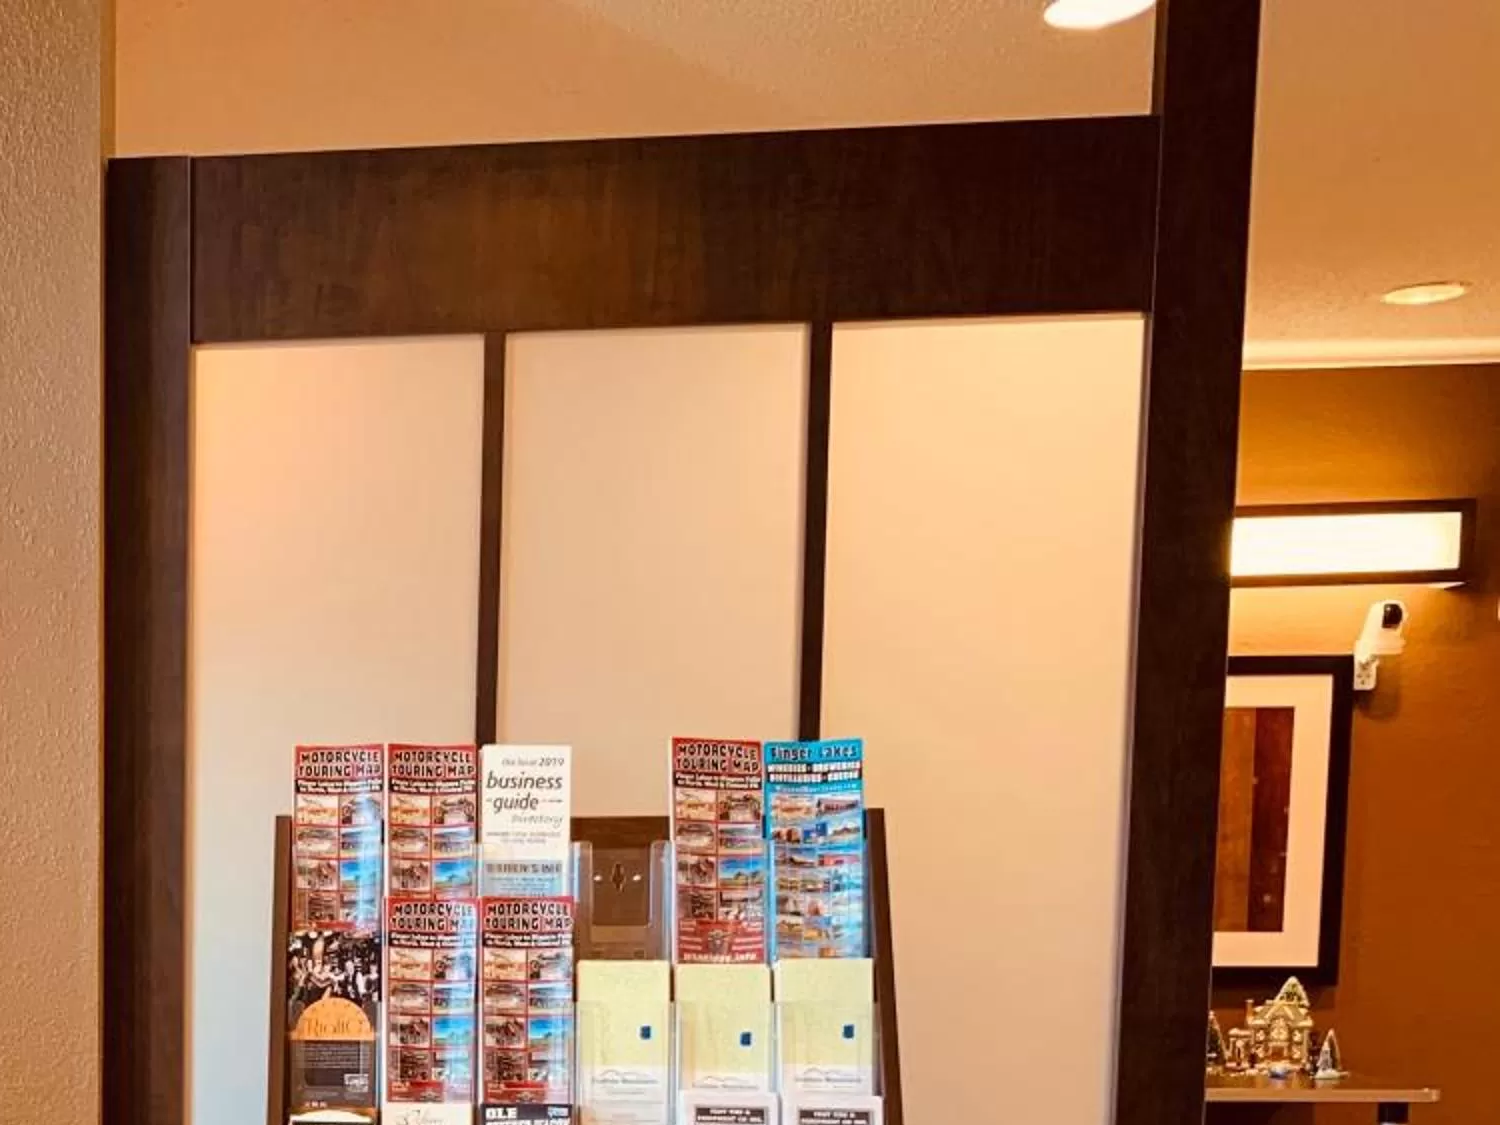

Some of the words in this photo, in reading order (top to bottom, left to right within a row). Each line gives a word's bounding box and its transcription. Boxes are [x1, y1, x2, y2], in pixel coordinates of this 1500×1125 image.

[301, 751, 380, 763] MOTORCYCLE
[394, 751, 471, 763] MOTORCYCLE
[678, 744, 757, 761] MOTORCYCLE
[770, 746, 813, 760] Finger
[819, 744, 857, 758] Lakes
[299, 765, 351, 777] TOURING
[355, 763, 380, 776] MAP
[391, 764, 443, 777] TOURING
[447, 764, 475, 777] MAP
[676, 759, 727, 771] TOURING
[733, 760, 759, 772] MAP
[486, 770, 563, 789] business
[493, 792, 539, 815] guide
[395, 903, 473, 916] MOTORCYCLE
[487, 903, 569, 916] MOTORCYCLE
[391, 917, 445, 930] TOURING
[485, 917, 539, 930] TOURING
[545, 918, 571, 929] MAP
[485, 1107, 518, 1119] OLE
